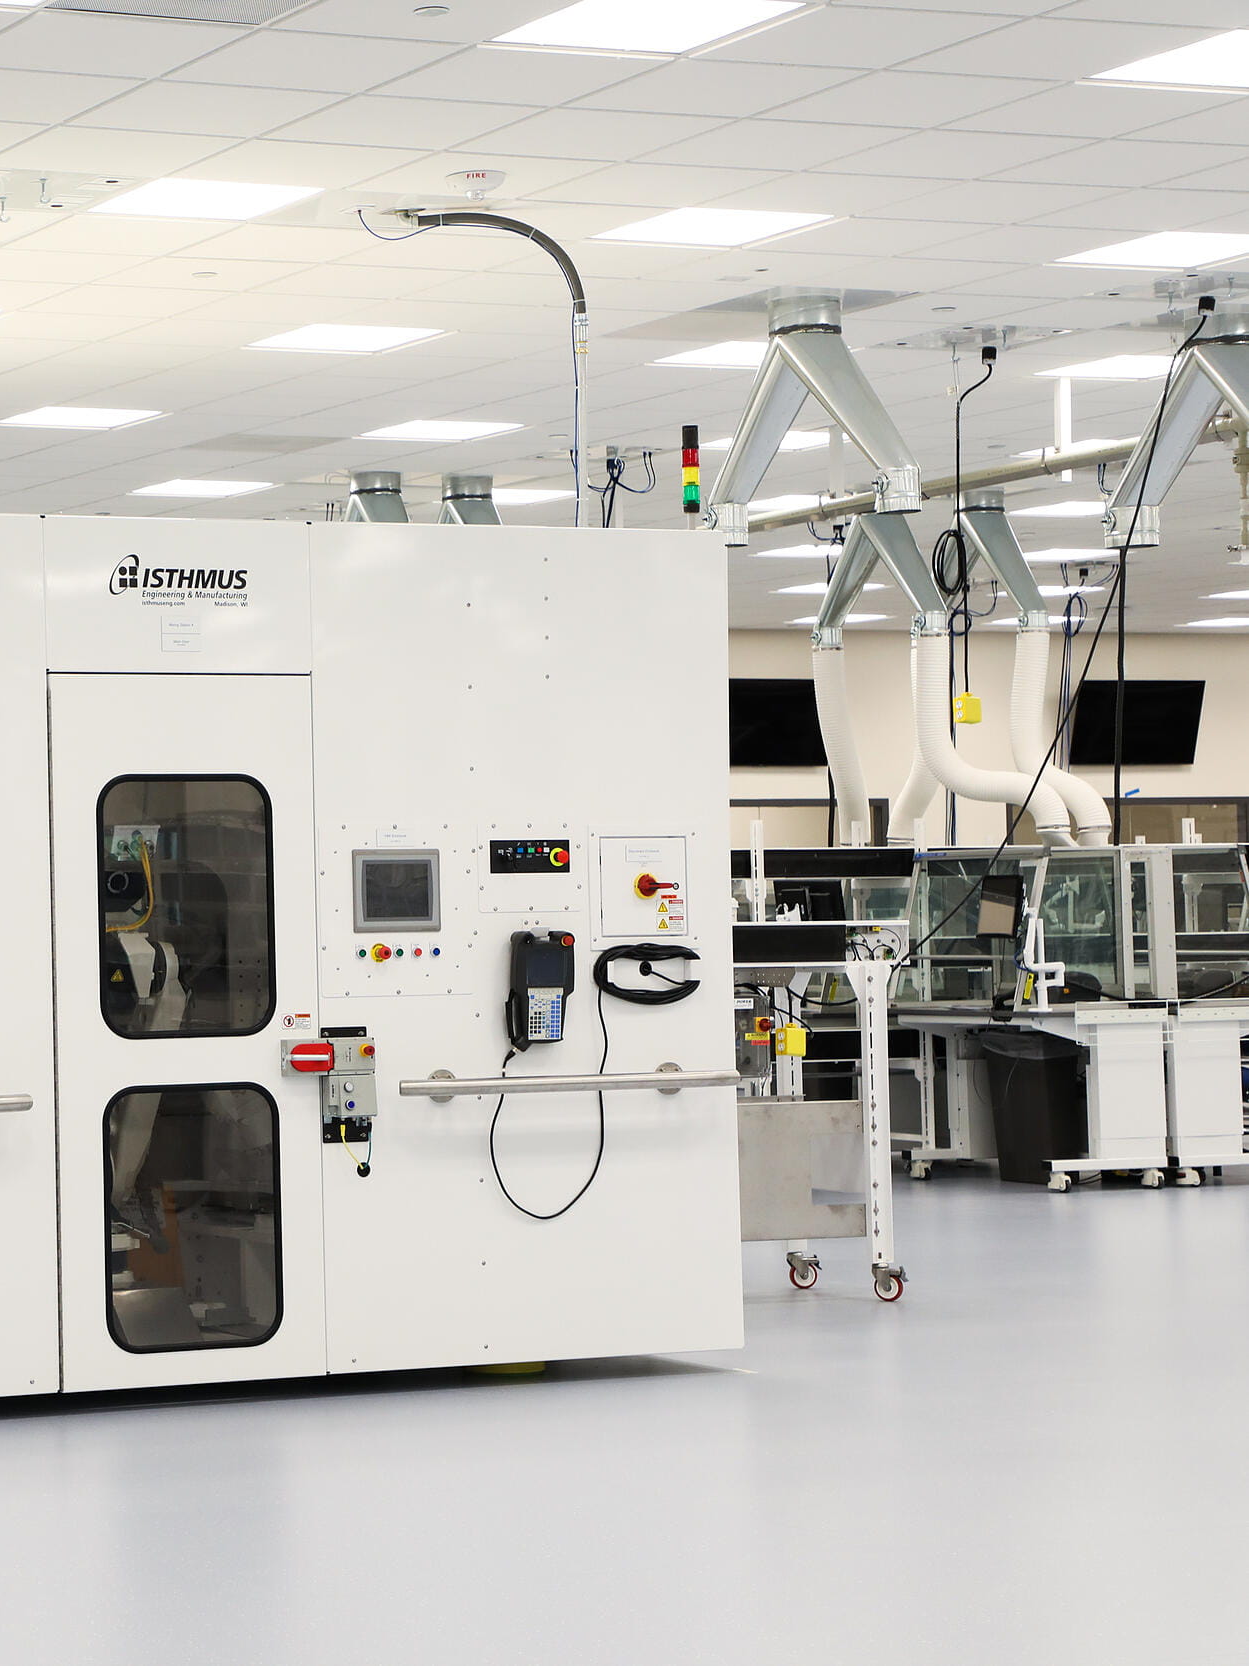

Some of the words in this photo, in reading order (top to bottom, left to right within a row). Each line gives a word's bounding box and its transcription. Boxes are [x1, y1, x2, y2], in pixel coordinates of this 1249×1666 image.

[142, 568, 248, 590] ISTHMUS
[141, 590, 186, 601] Engineering
[187, 591, 193, 599] &
[194, 591, 248, 602] Manufacturing
